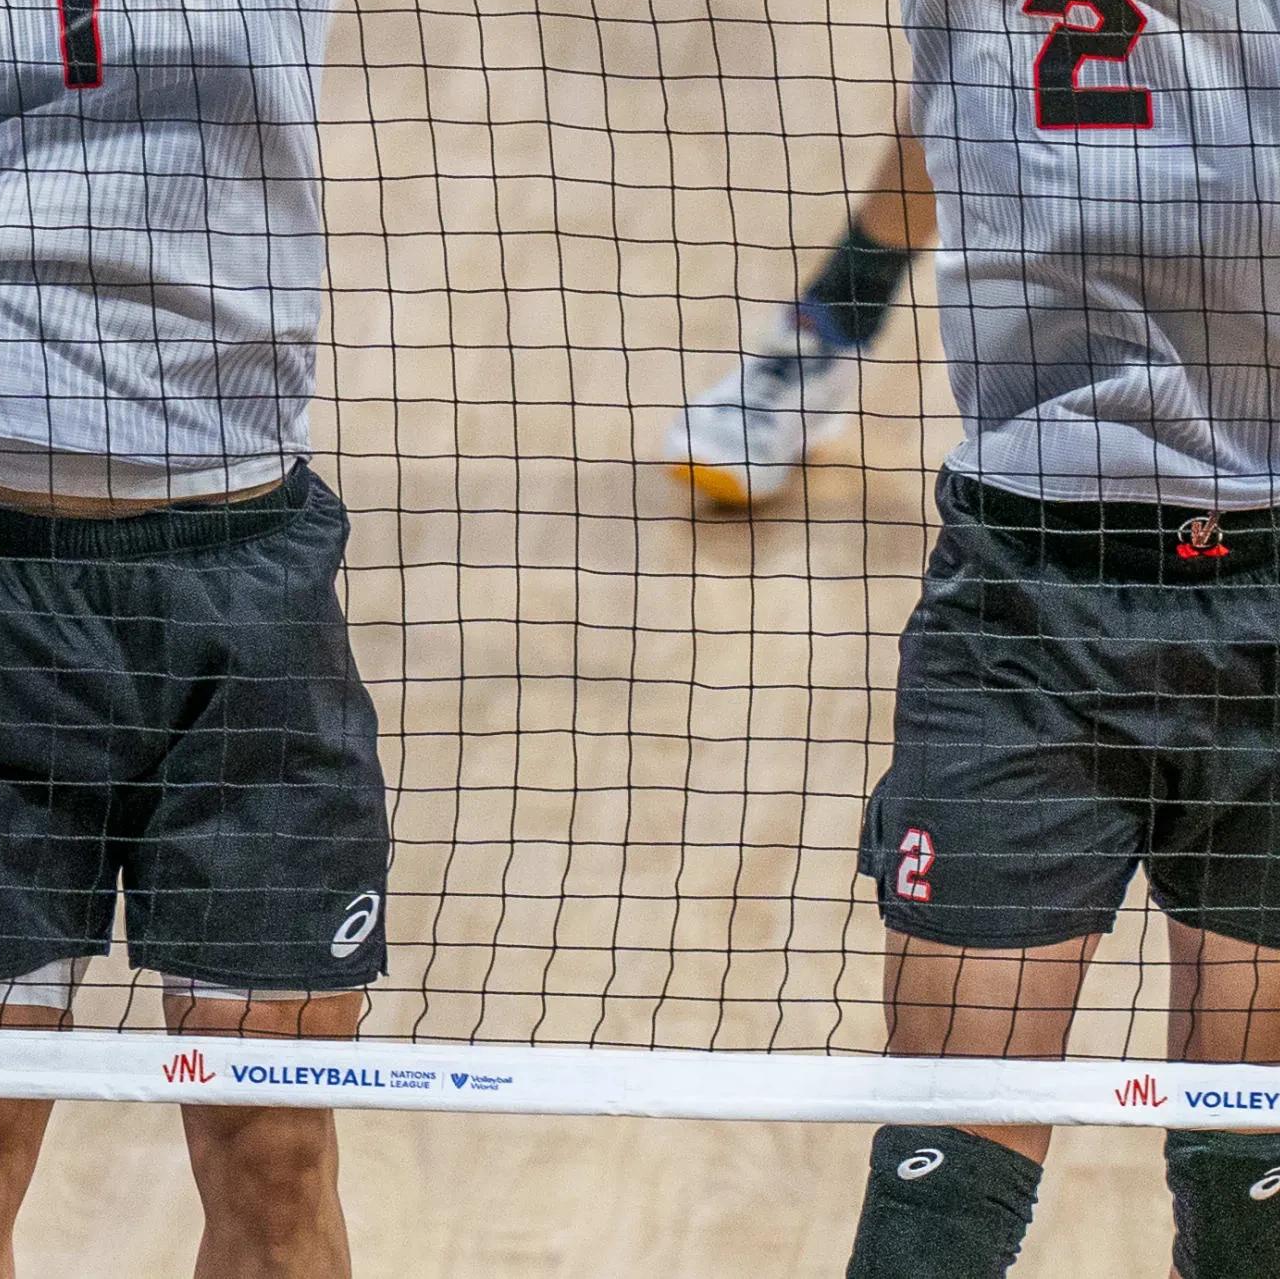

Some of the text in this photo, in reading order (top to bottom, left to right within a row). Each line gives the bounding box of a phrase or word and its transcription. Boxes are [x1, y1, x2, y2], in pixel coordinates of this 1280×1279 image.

[895, 827, 935, 901] 2
[162, 1049, 385, 1087] VNL VOLLEYBALL
[390, 1070, 436, 1080] NATIONS
[390, 1080, 430, 1089] LEAGUE
[1115, 1074, 1168, 1108] VNL
